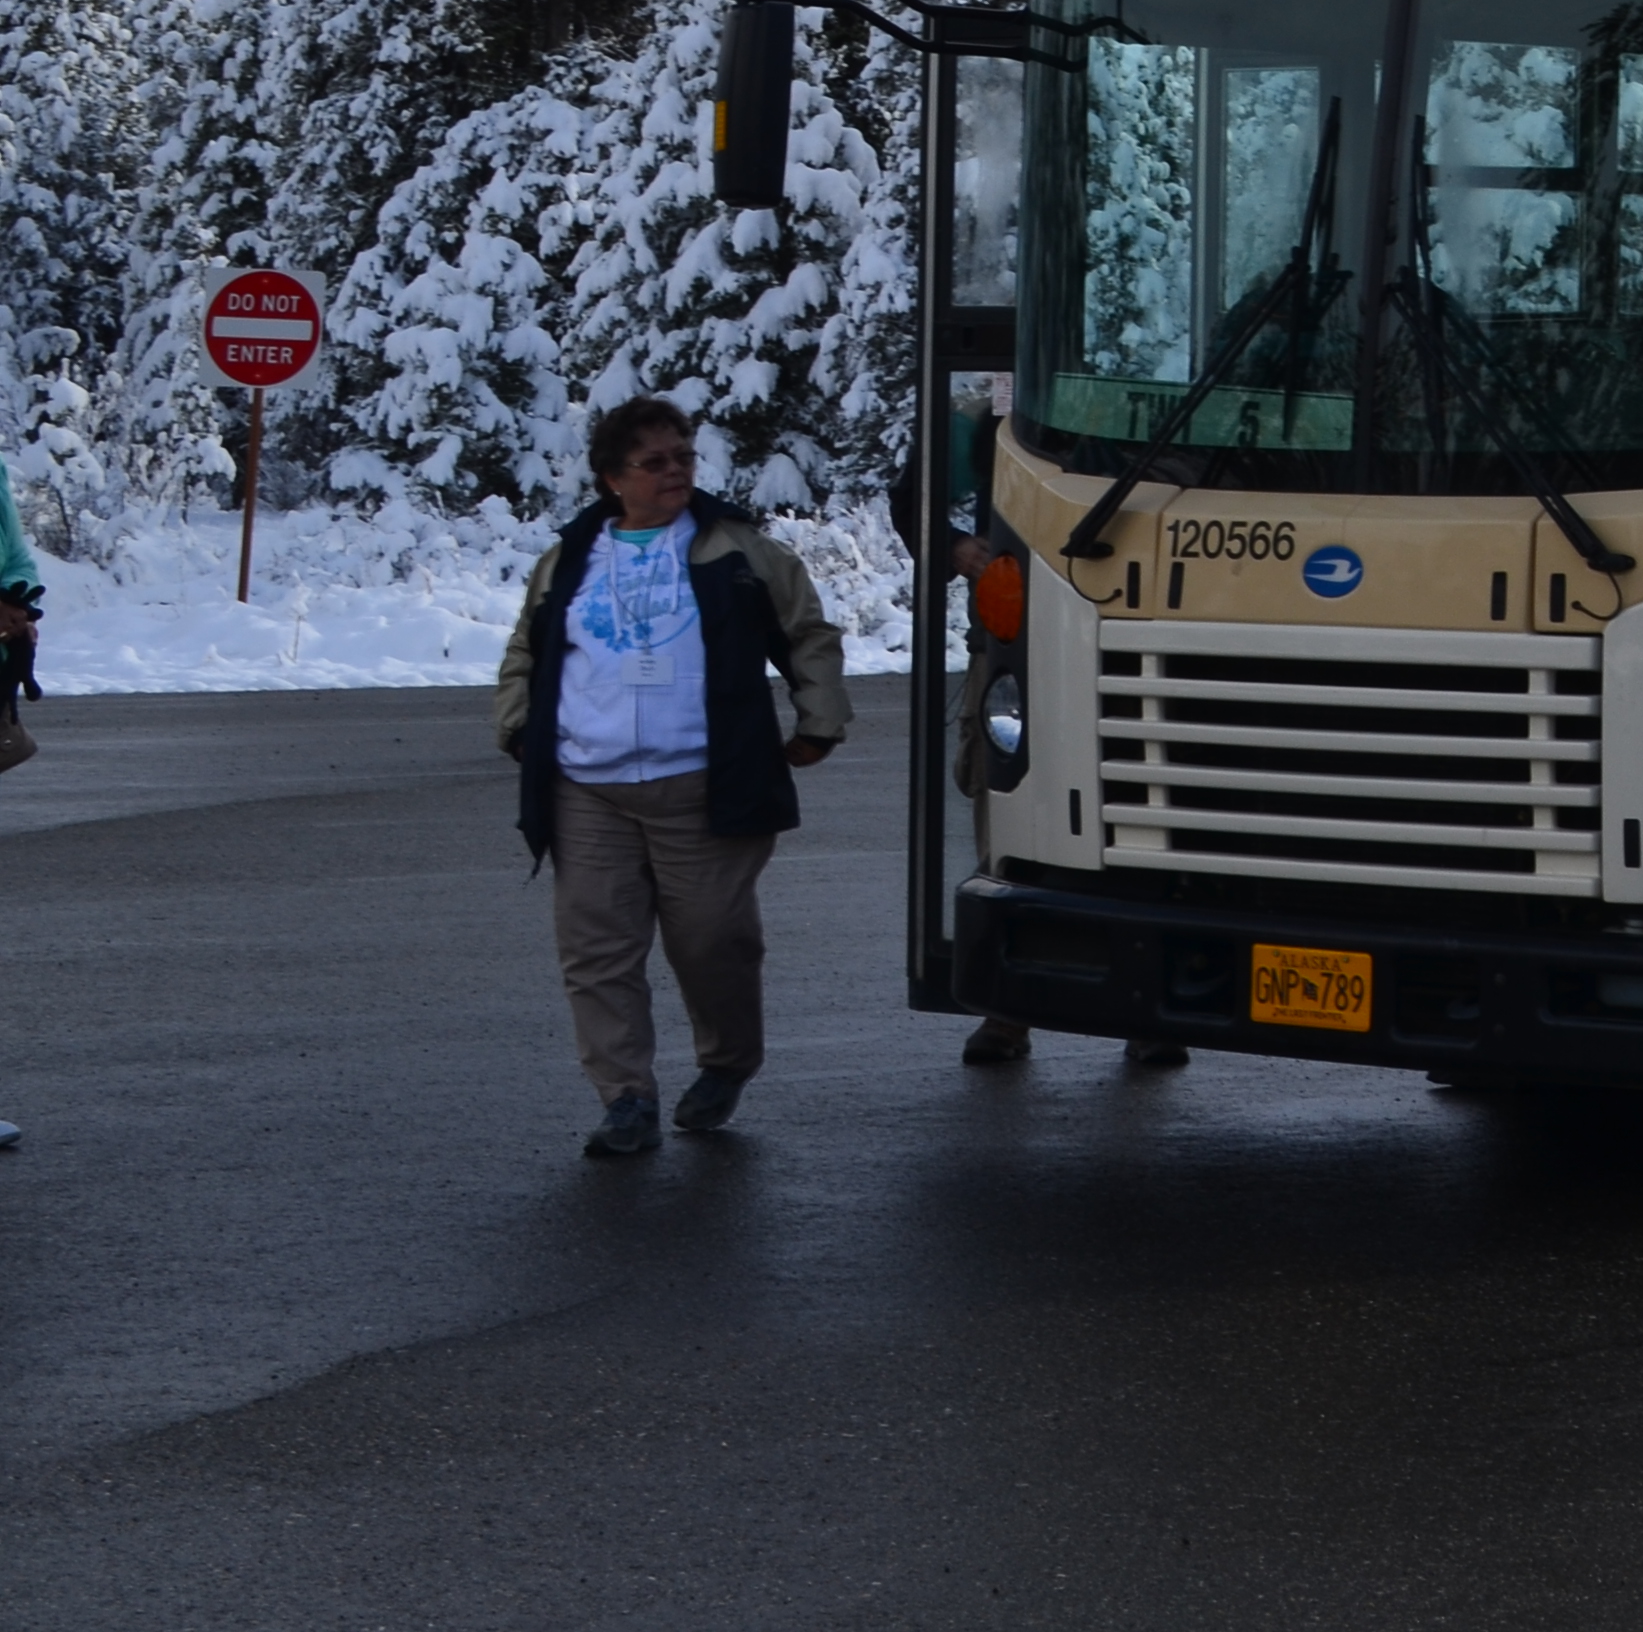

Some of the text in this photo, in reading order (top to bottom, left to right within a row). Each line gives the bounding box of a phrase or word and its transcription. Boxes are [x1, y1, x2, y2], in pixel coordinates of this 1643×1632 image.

[227, 293, 302, 313] DO NOT
[226, 344, 294, 365] ENTER
[1166, 519, 1297, 561] 120566
[1281, 954, 1342, 971] ALASKA
[1257, 967, 1364, 1012] GNP 789
